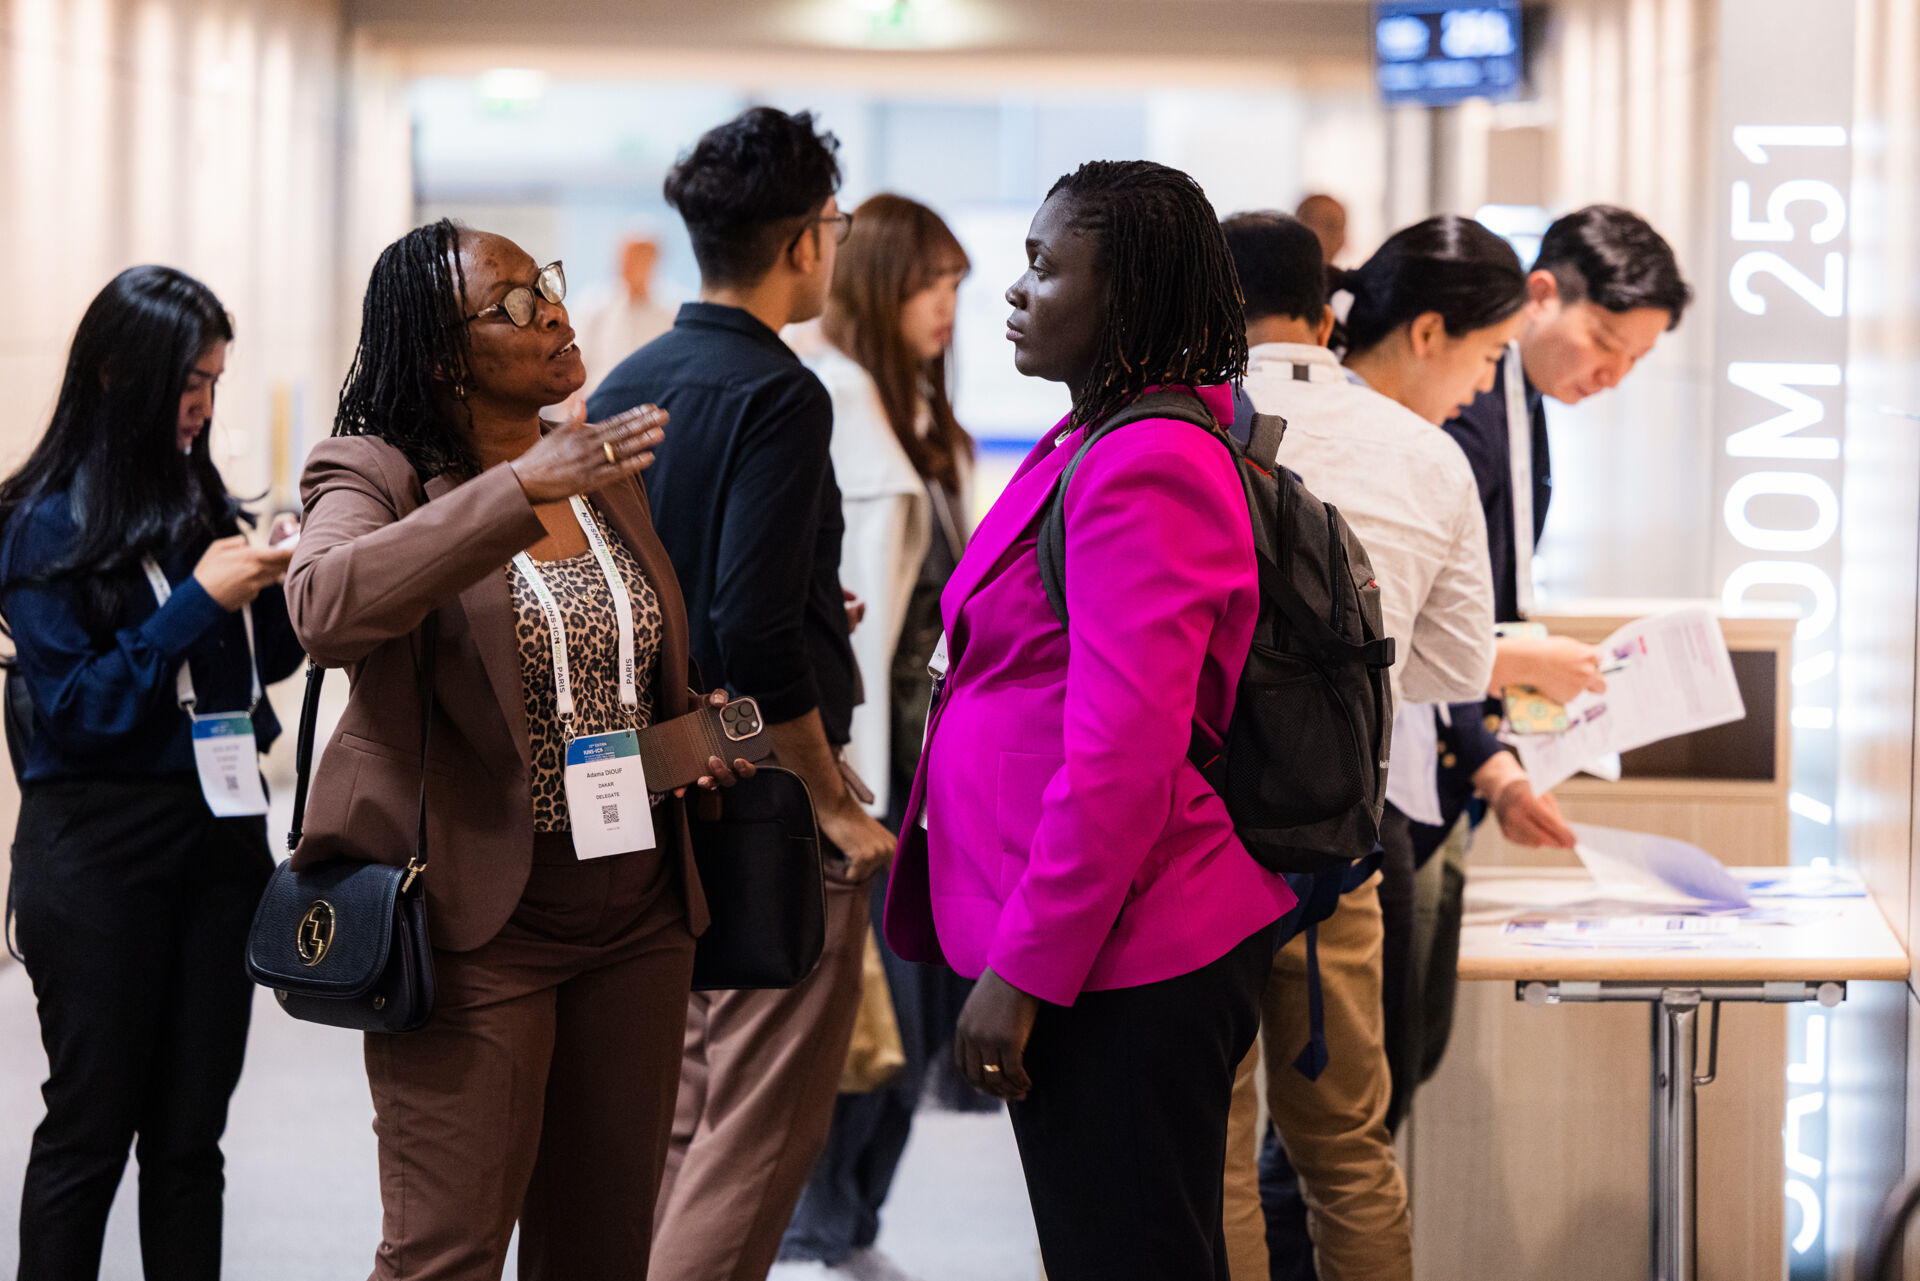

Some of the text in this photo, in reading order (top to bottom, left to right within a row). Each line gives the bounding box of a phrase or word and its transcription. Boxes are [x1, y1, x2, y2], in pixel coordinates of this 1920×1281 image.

[1729, 124, 1848, 318] 251
[581, 511, 604, 547] IUNS-ICN
[544, 601, 560, 644] IUNS-ICN
[556, 666, 566, 694] PARIS
[625, 658, 633, 685] PARIS
[598, 781, 615, 789] DAKAR
[604, 767, 623, 776] DIOUF
[595, 791, 620, 800] DELEGATE
